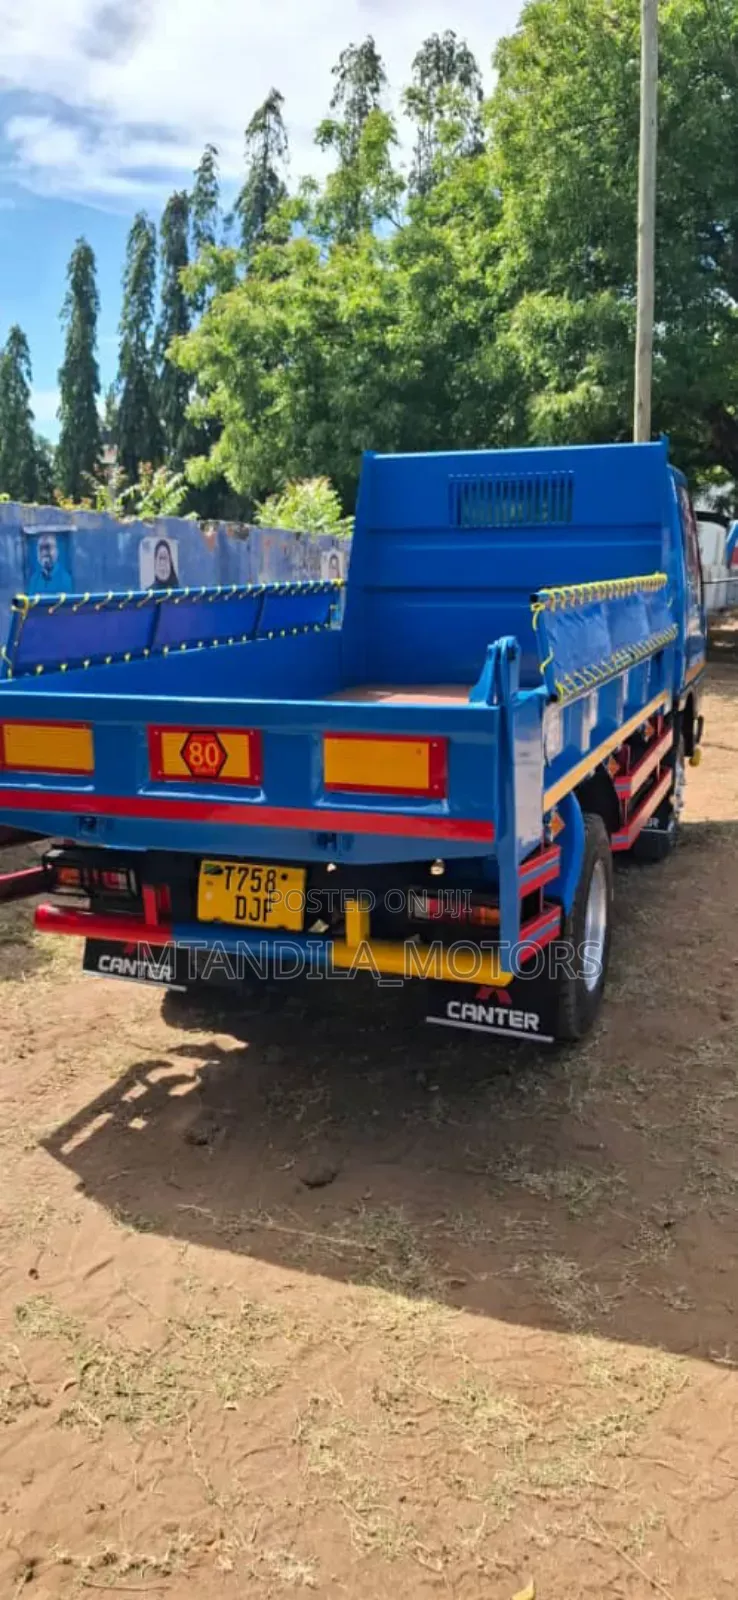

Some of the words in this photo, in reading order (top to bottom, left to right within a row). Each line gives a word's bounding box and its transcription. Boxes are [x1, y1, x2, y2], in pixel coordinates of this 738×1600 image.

[189, 742, 219, 768] 80
[224, 865, 277, 893] T758
[447, 1001, 540, 1031] CANTER
